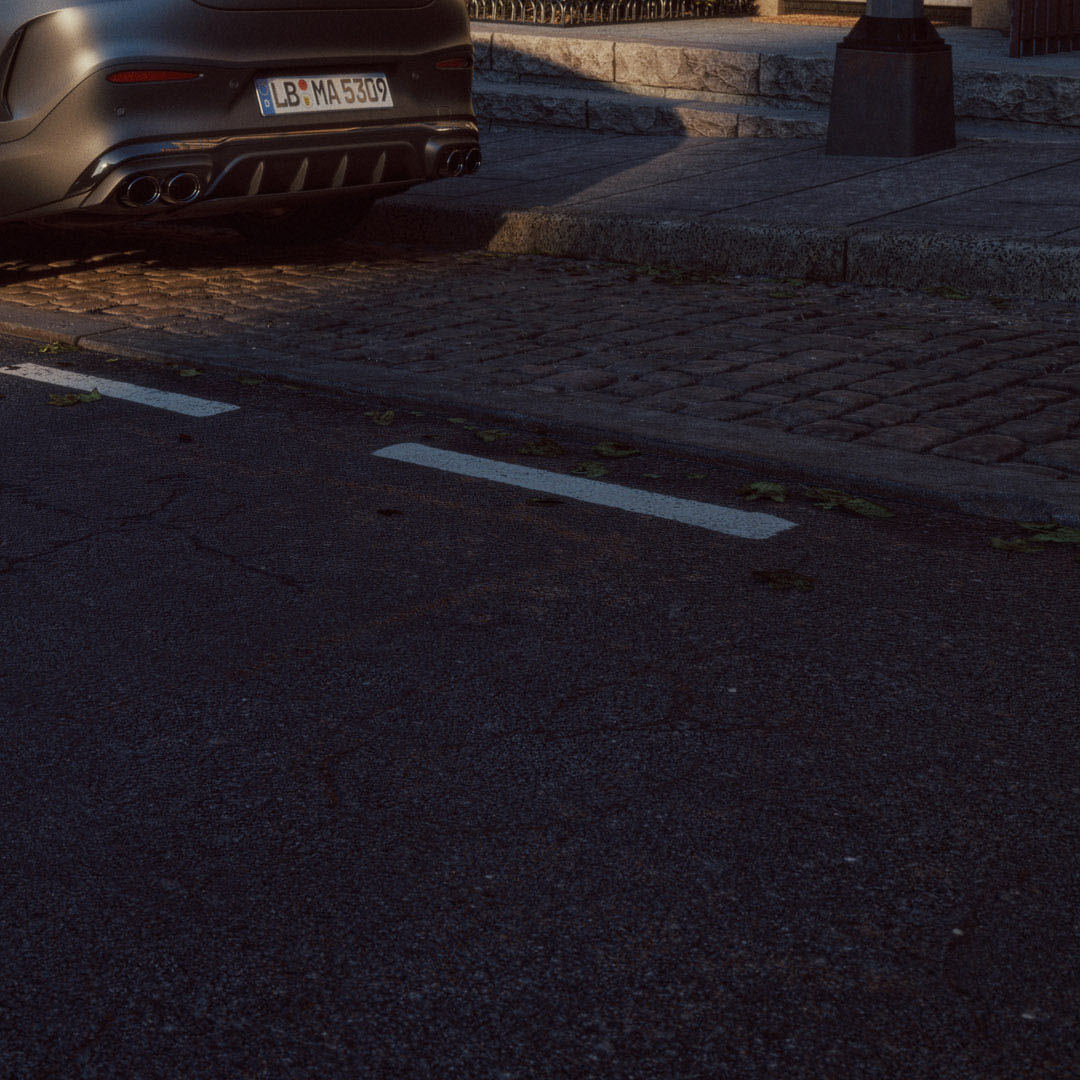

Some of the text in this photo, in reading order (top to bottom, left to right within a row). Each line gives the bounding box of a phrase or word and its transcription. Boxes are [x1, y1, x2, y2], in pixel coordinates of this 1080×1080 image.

[271, 81, 300, 108] LB
[311, 79, 341, 105] MA
[340, 77, 388, 104] 5309
